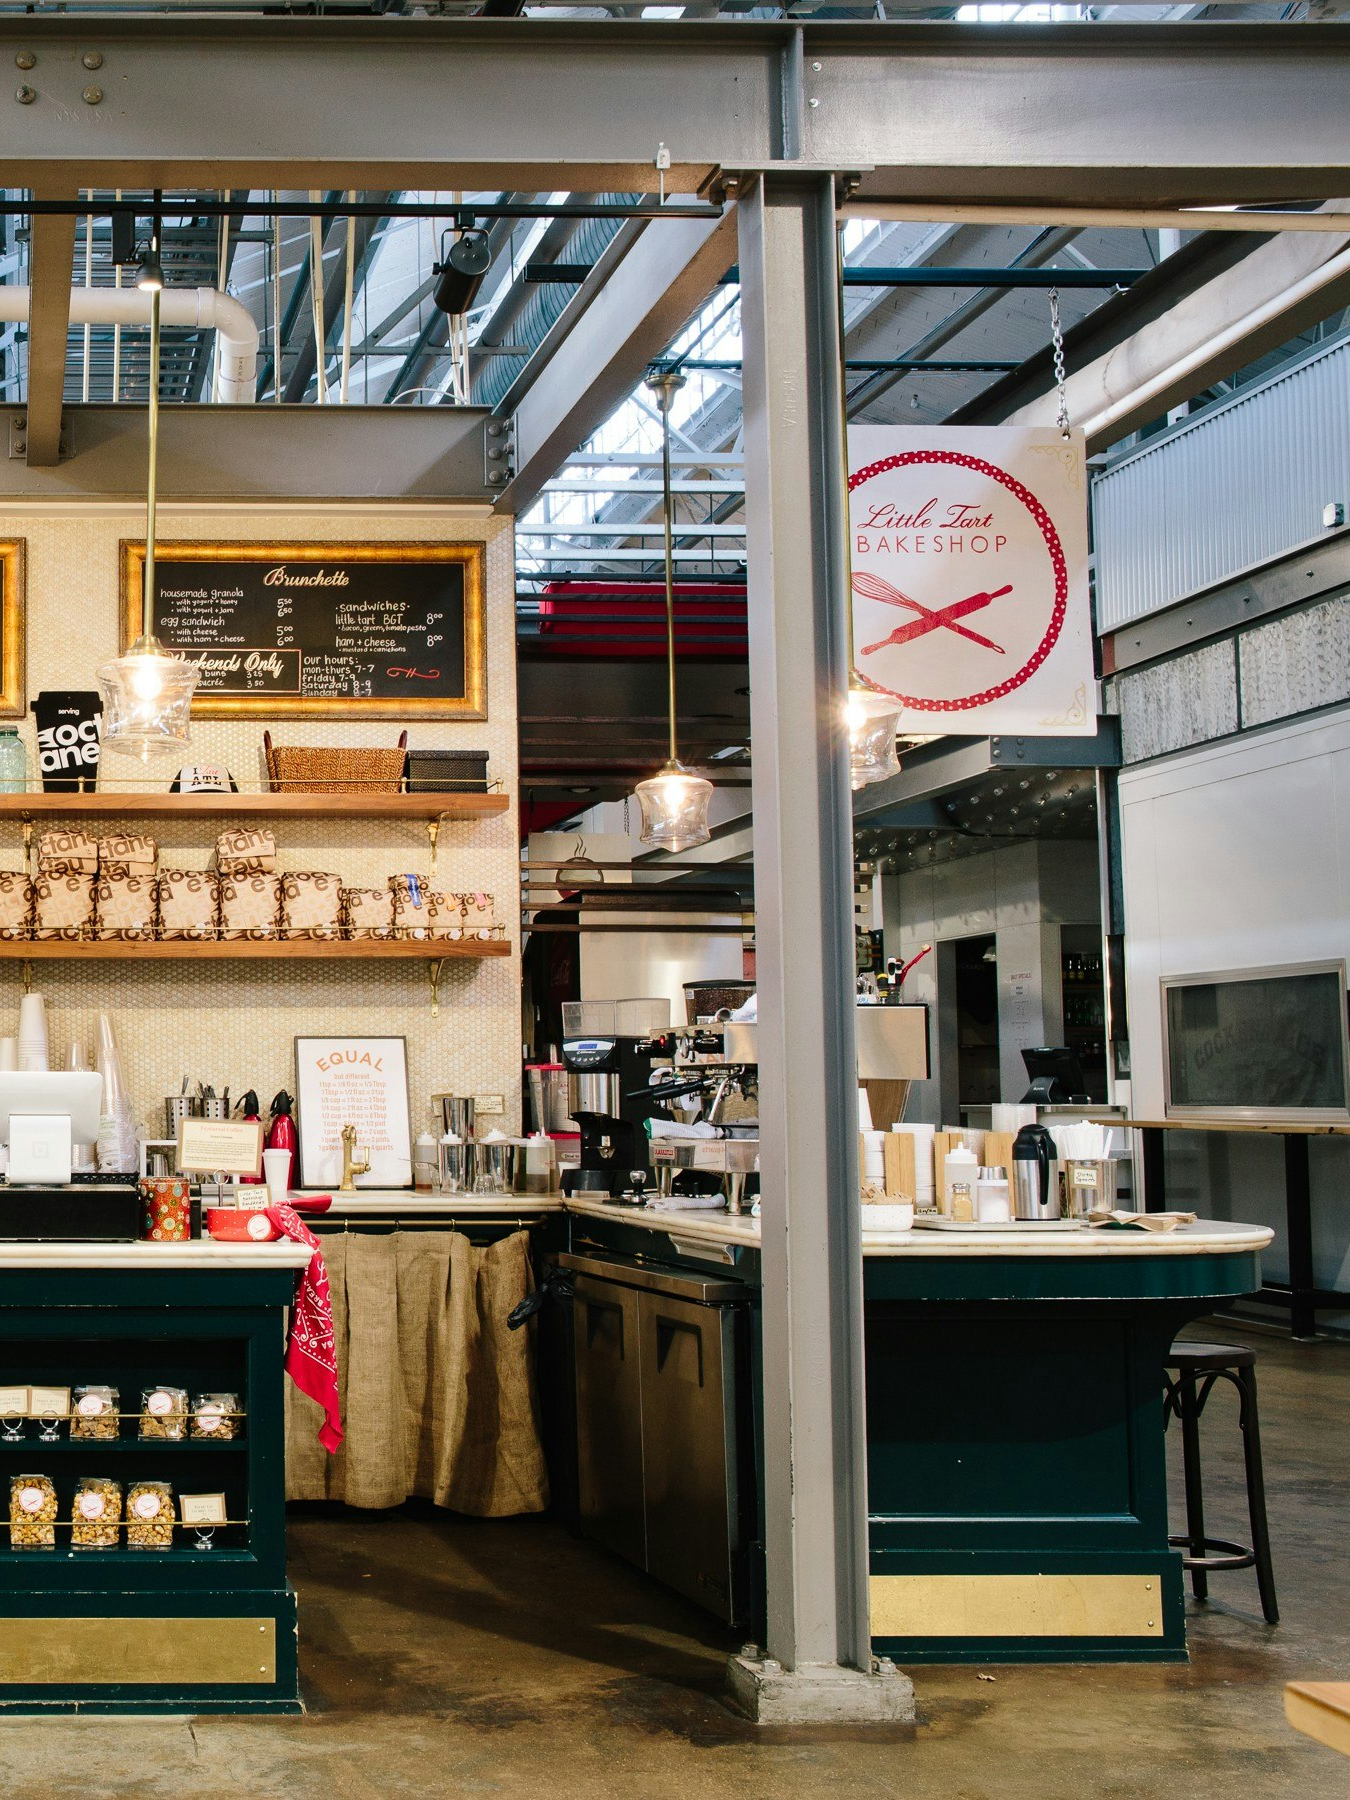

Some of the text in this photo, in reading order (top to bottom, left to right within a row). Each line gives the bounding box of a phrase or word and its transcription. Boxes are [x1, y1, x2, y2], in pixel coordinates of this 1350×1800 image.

[857, 498, 994, 529] Little Tart
[857, 535, 1007, 553] BAKESHOP
[262, 565, 350, 588] Brunchette
[161, 587, 244, 599] housemade granola
[161, 616, 225, 626] egg sandwich
[336, 614, 355, 624] little
[358, 614, 375, 624] tart
[384, 614, 403, 624] BGT
[407, 625, 426, 633] pesto
[336, 636, 354, 647] ham
[364, 637, 396, 646] cheese
[244, 652, 284, 678] Only
[325, 655, 358, 665] hours:
[355, 665, 374, 673] 7-7
[302, 674, 335, 683] friday
[353, 680, 371, 689] 8-9
[191, 776, 221, 786] ATL
[316, 1050, 383, 1072] EQUAL
